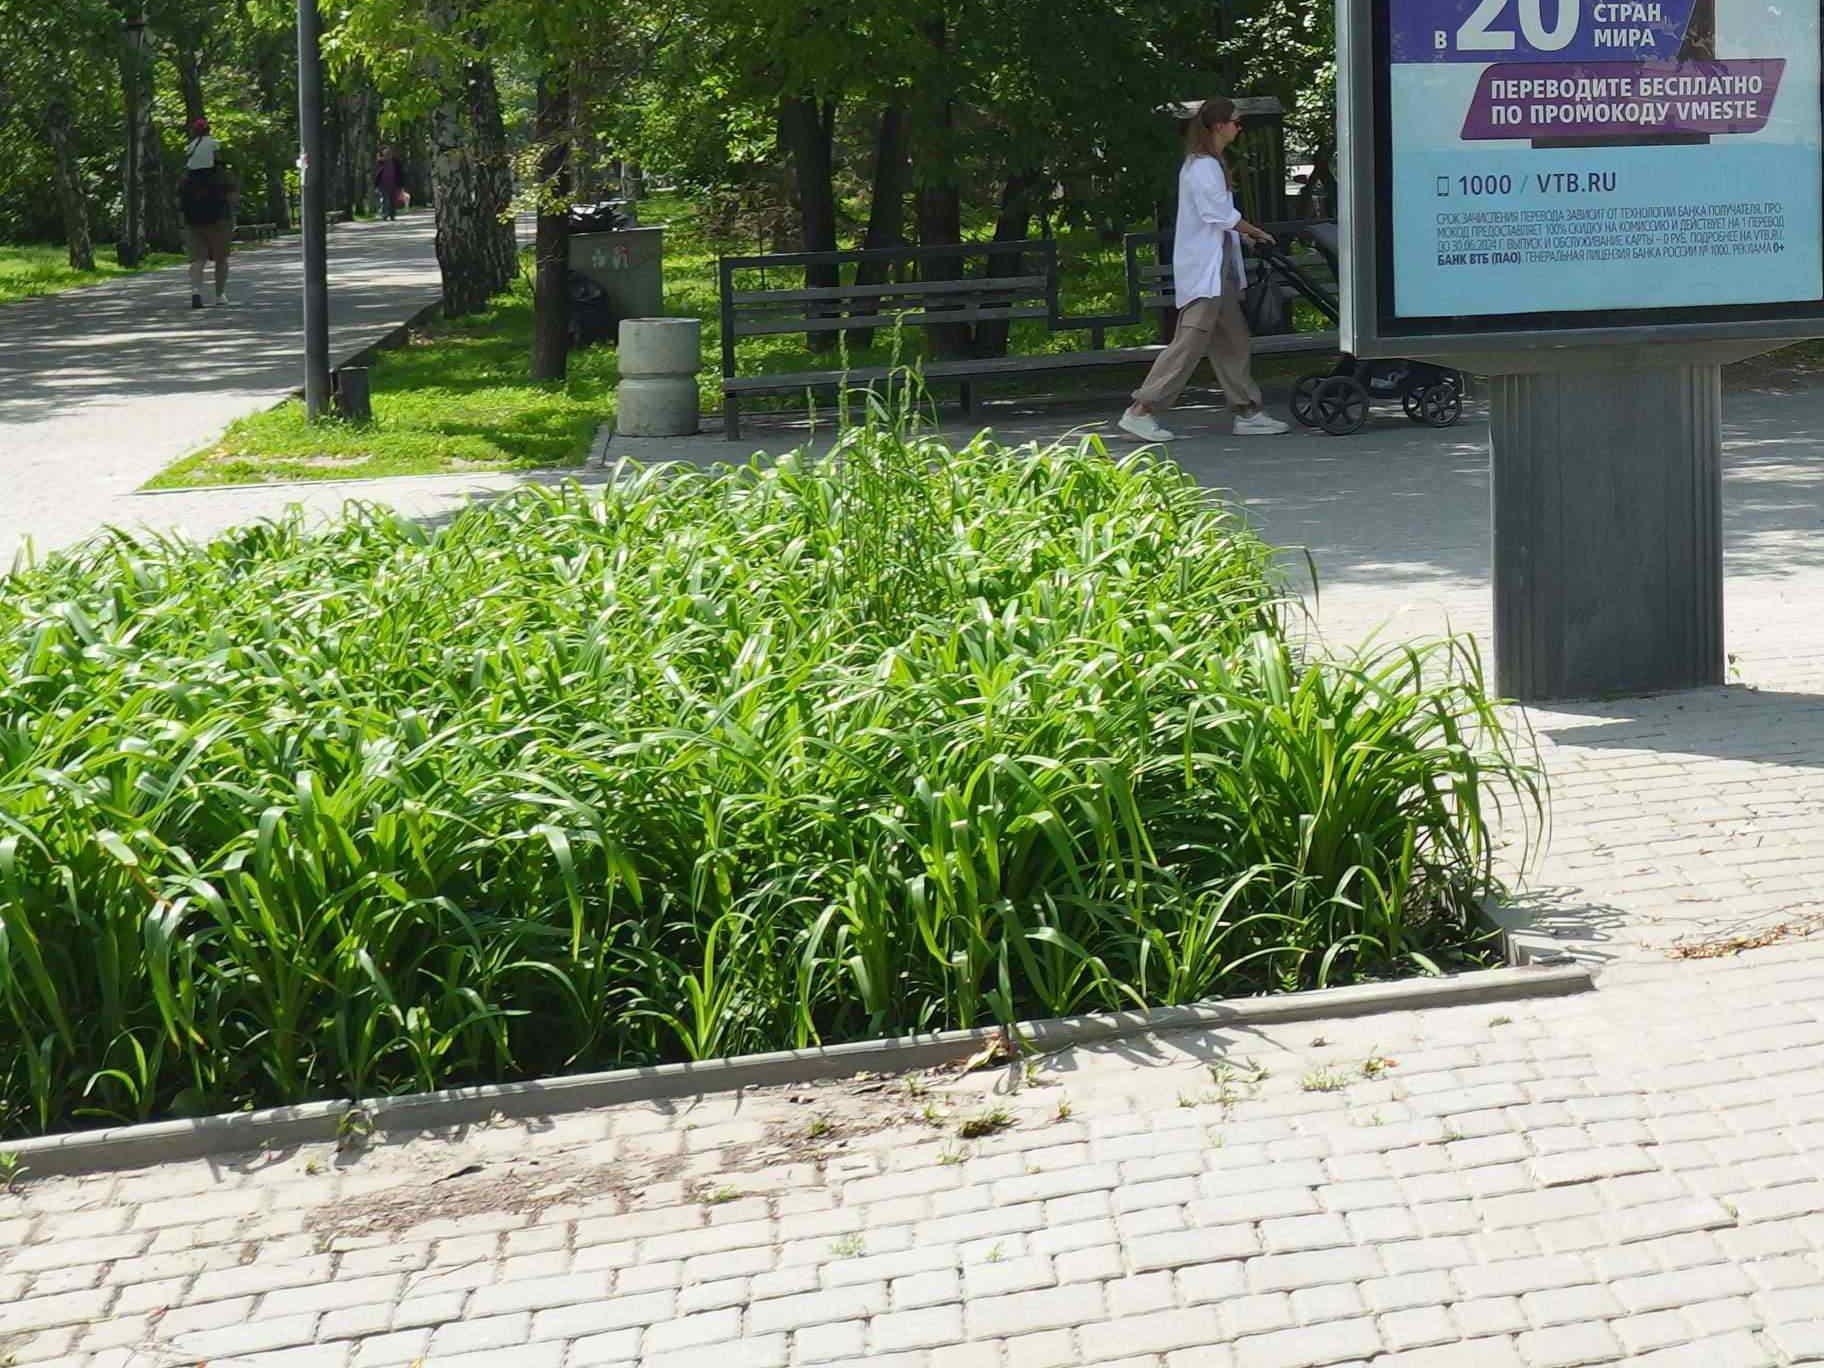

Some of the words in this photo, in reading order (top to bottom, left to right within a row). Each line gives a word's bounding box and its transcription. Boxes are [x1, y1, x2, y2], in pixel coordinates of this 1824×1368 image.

[1593, 2, 1662, 23] СТРАН
[1434, 30, 1448, 50] В
[1593, 28, 1656, 49] МИРА
[1490, 78, 1632, 102] ПЕРЕВОДИТЕ
[1638, 75, 1764, 97] БЕСПЛАТНО
[1490, 105, 1523, 125] ПО
[1530, 102, 1670, 126] ПРОМОКОДУ
[1675, 99, 1758, 121] VMESTE
[1457, 176, 1512, 195] 1000
[1537, 172, 1618, 193] VTB.RU
[1437, 254, 1467, 266] БАНК
[1470, 253, 1489, 265] ВТБ
